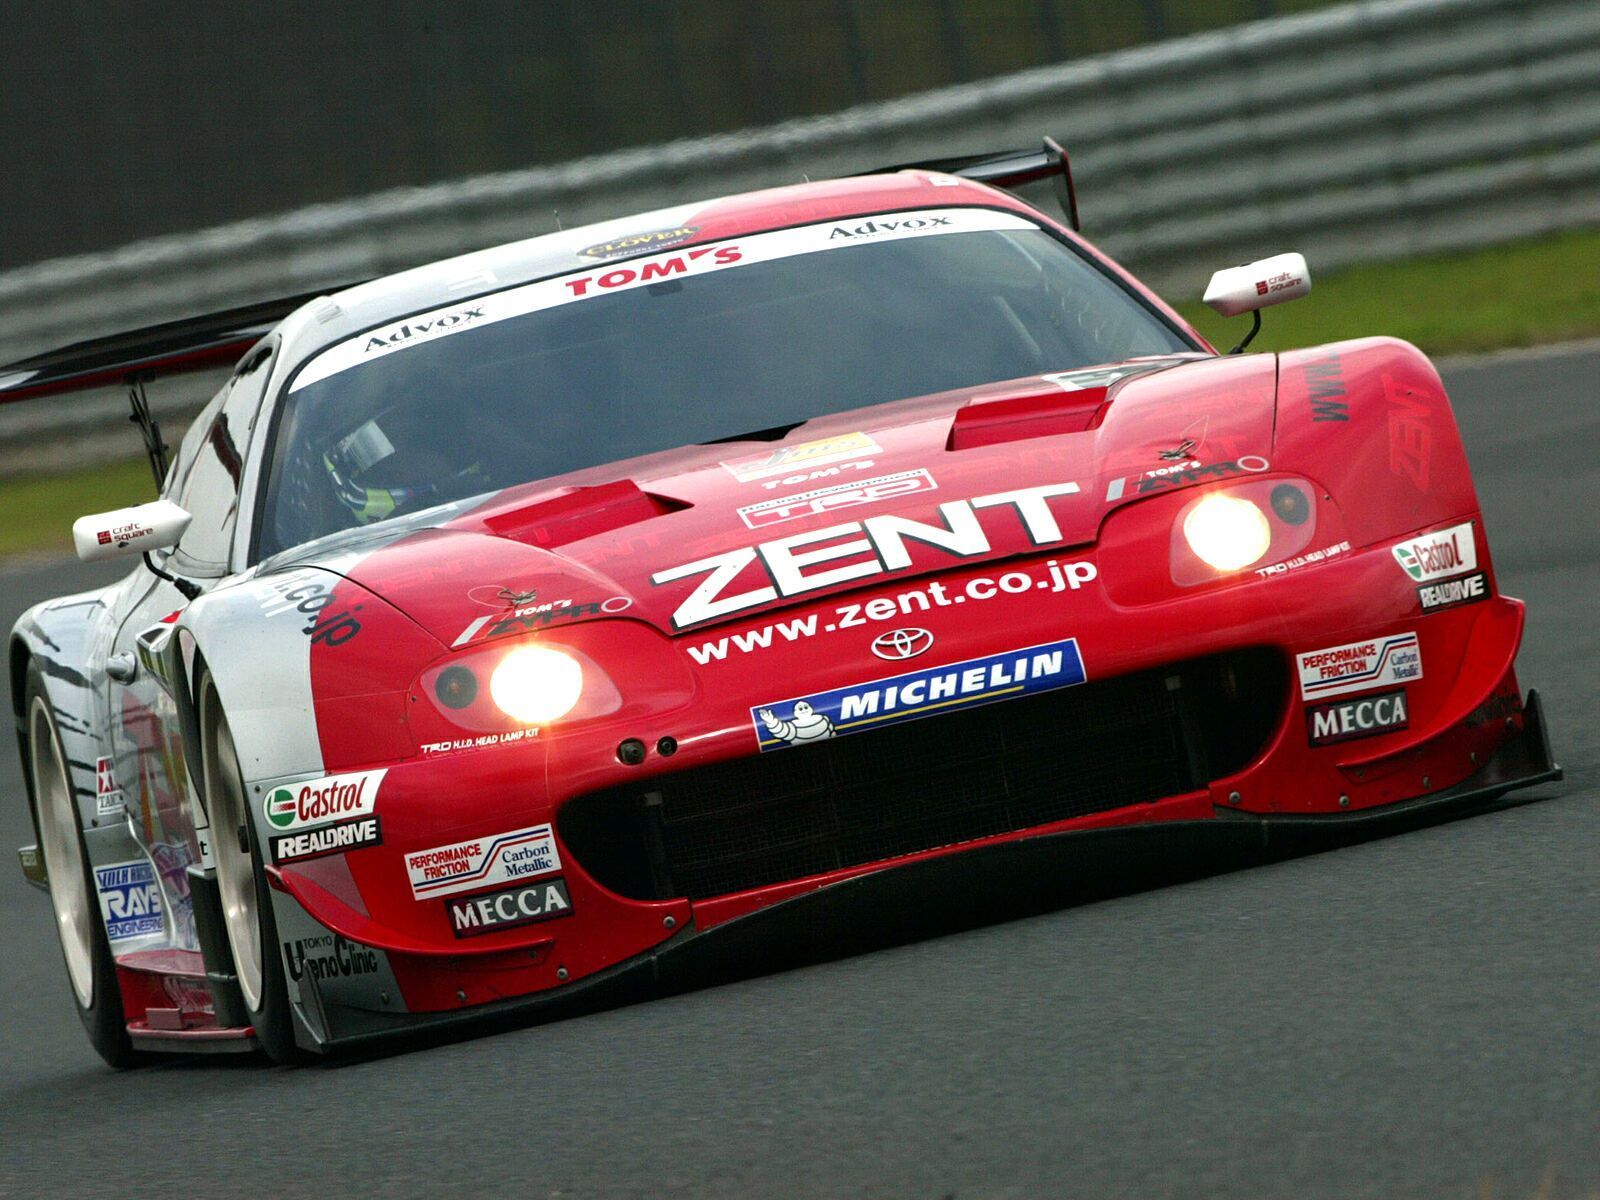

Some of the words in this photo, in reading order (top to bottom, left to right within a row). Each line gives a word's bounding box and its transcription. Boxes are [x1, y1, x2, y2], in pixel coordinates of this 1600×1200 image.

[829, 216, 954, 240] Advox
[565, 245, 743, 297] TOM'S
[364, 306, 487, 354] Advox
[761, 459, 876, 490] TOM'S
[753, 478, 921, 514] TRD
[112, 522, 140, 534] craft
[113, 527, 154, 542] square
[650, 481, 1081, 629] ZENT
[1412, 533, 1464, 575] Castrol
[514, 599, 573, 618] TOM'S
[686, 558, 1098, 665] www.zent.co.jp
[1302, 643, 1377, 669] PERFORMANCE
[1320, 658, 1368, 679] FRICTION
[839, 650, 1063, 720] MICHELIN
[1313, 695, 1407, 738] MECCA
[420, 741, 452, 754] TRD
[475, 734, 498, 747] HEAD
[500, 730, 525, 743] LAMP
[525, 727, 540, 738] KIT
[297, 775, 368, 822] Castrol
[277, 819, 377, 860] REALDRIVE
[502, 844, 551, 863] Carbon
[409, 843, 482, 870] PERFORMANCE
[424, 859, 471, 881] FRICTION
[505, 857, 553, 878] Metallic
[101, 885, 162, 920] RAYS
[452, 885, 568, 930] MECCA
[303, 935, 333, 950] TOKYO
